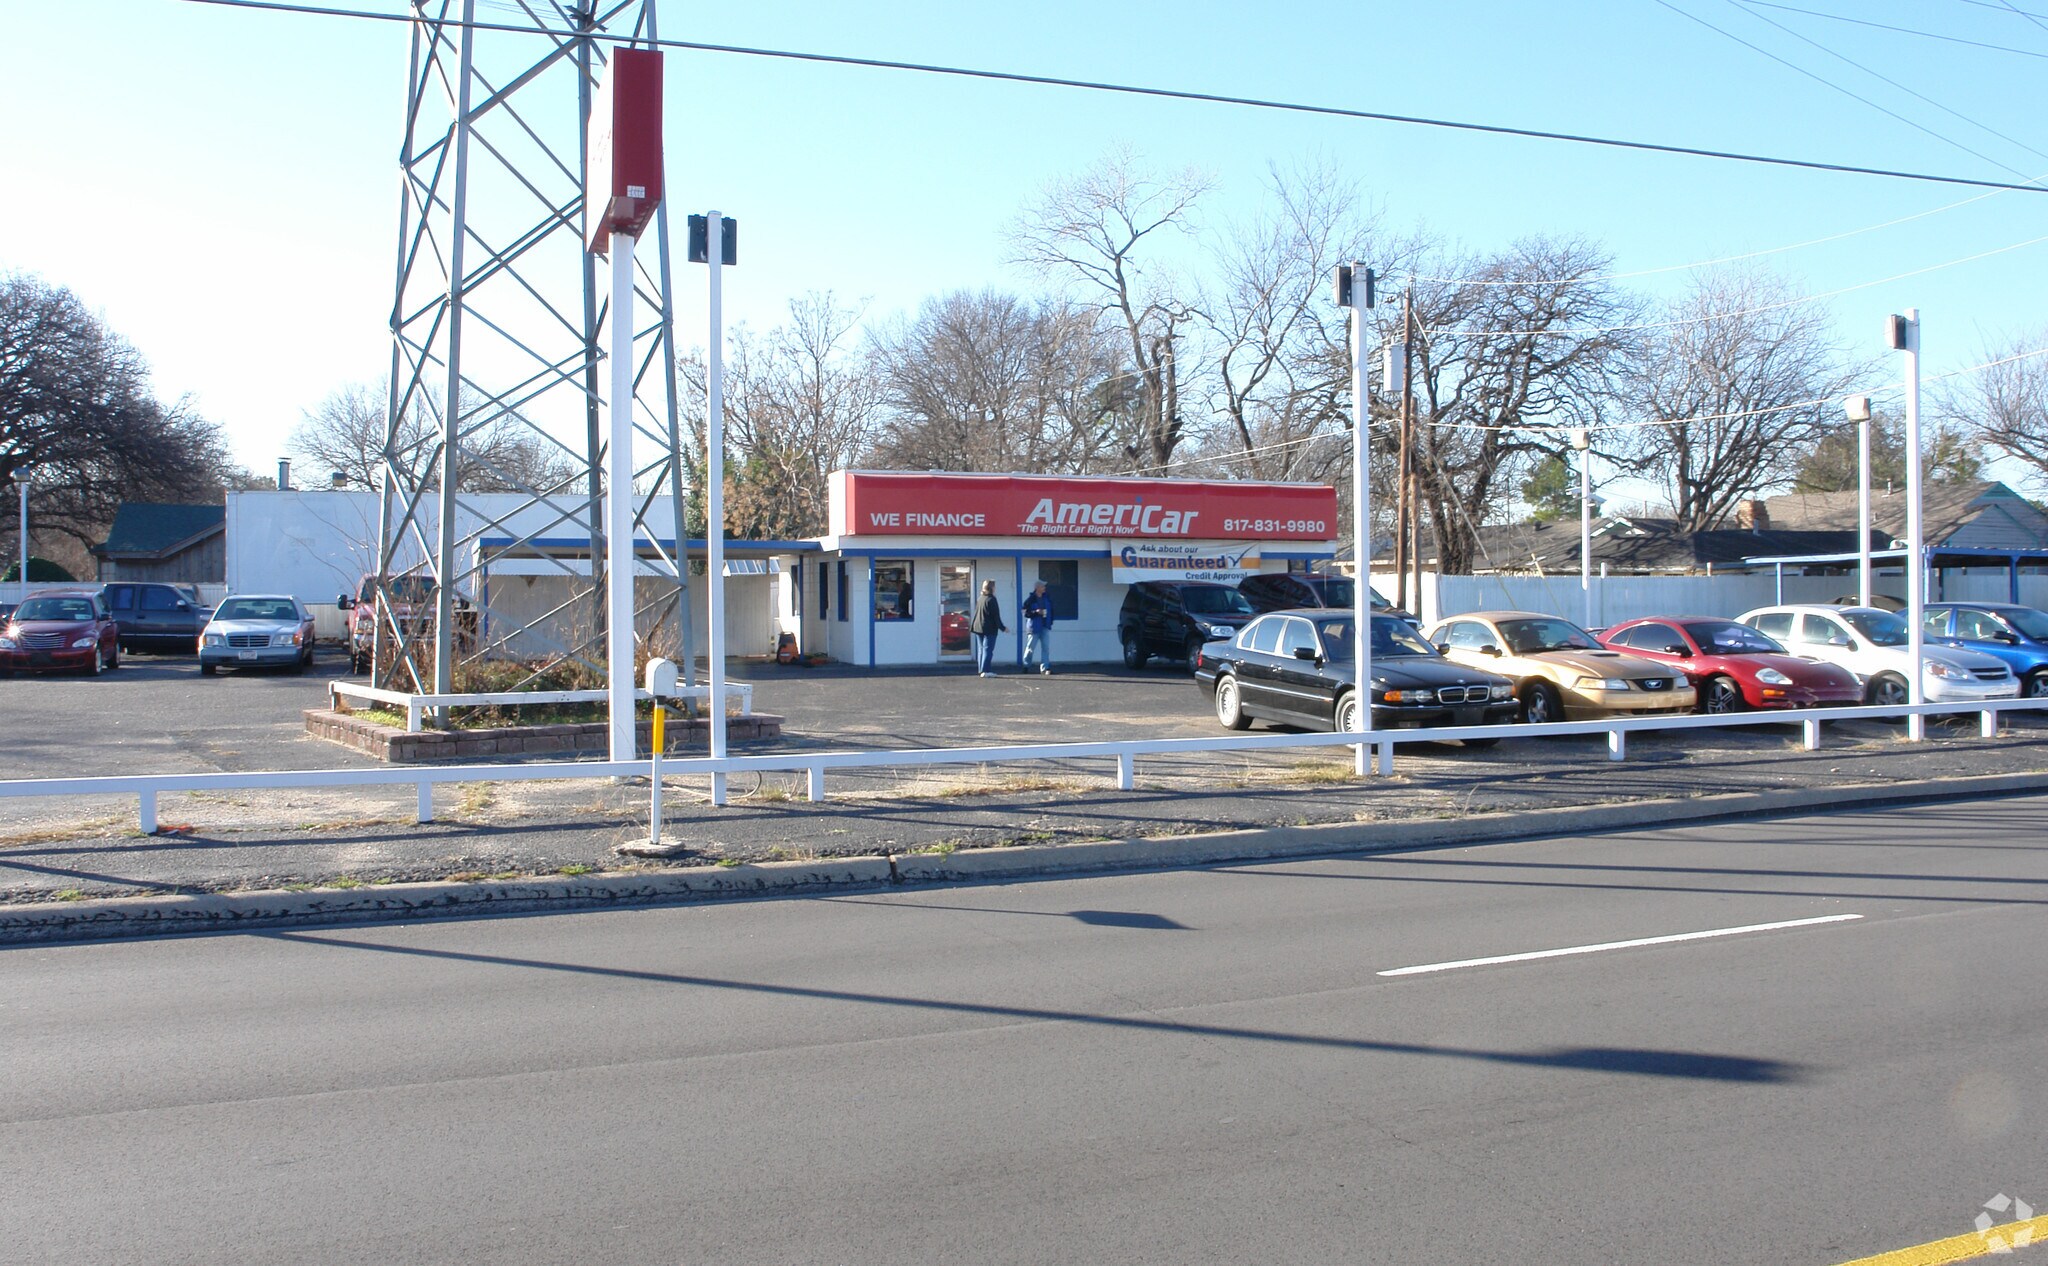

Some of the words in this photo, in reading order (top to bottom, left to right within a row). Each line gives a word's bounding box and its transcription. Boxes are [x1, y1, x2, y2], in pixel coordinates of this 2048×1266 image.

[870, 512, 900, 526] WE
[905, 513, 985, 527] FINANCE
[1026, 496, 1198, 534] AmeriCar
[1041, 524, 1067, 535] Right
[1069, 525, 1084, 534] Car
[1088, 525, 1113, 535] Right
[1224, 519, 1325, 532] 817-831-9980
[1158, 545, 1182, 553] about
[1121, 546, 1226, 569] Guaranteed
[1185, 572, 1211, 580] Credit
